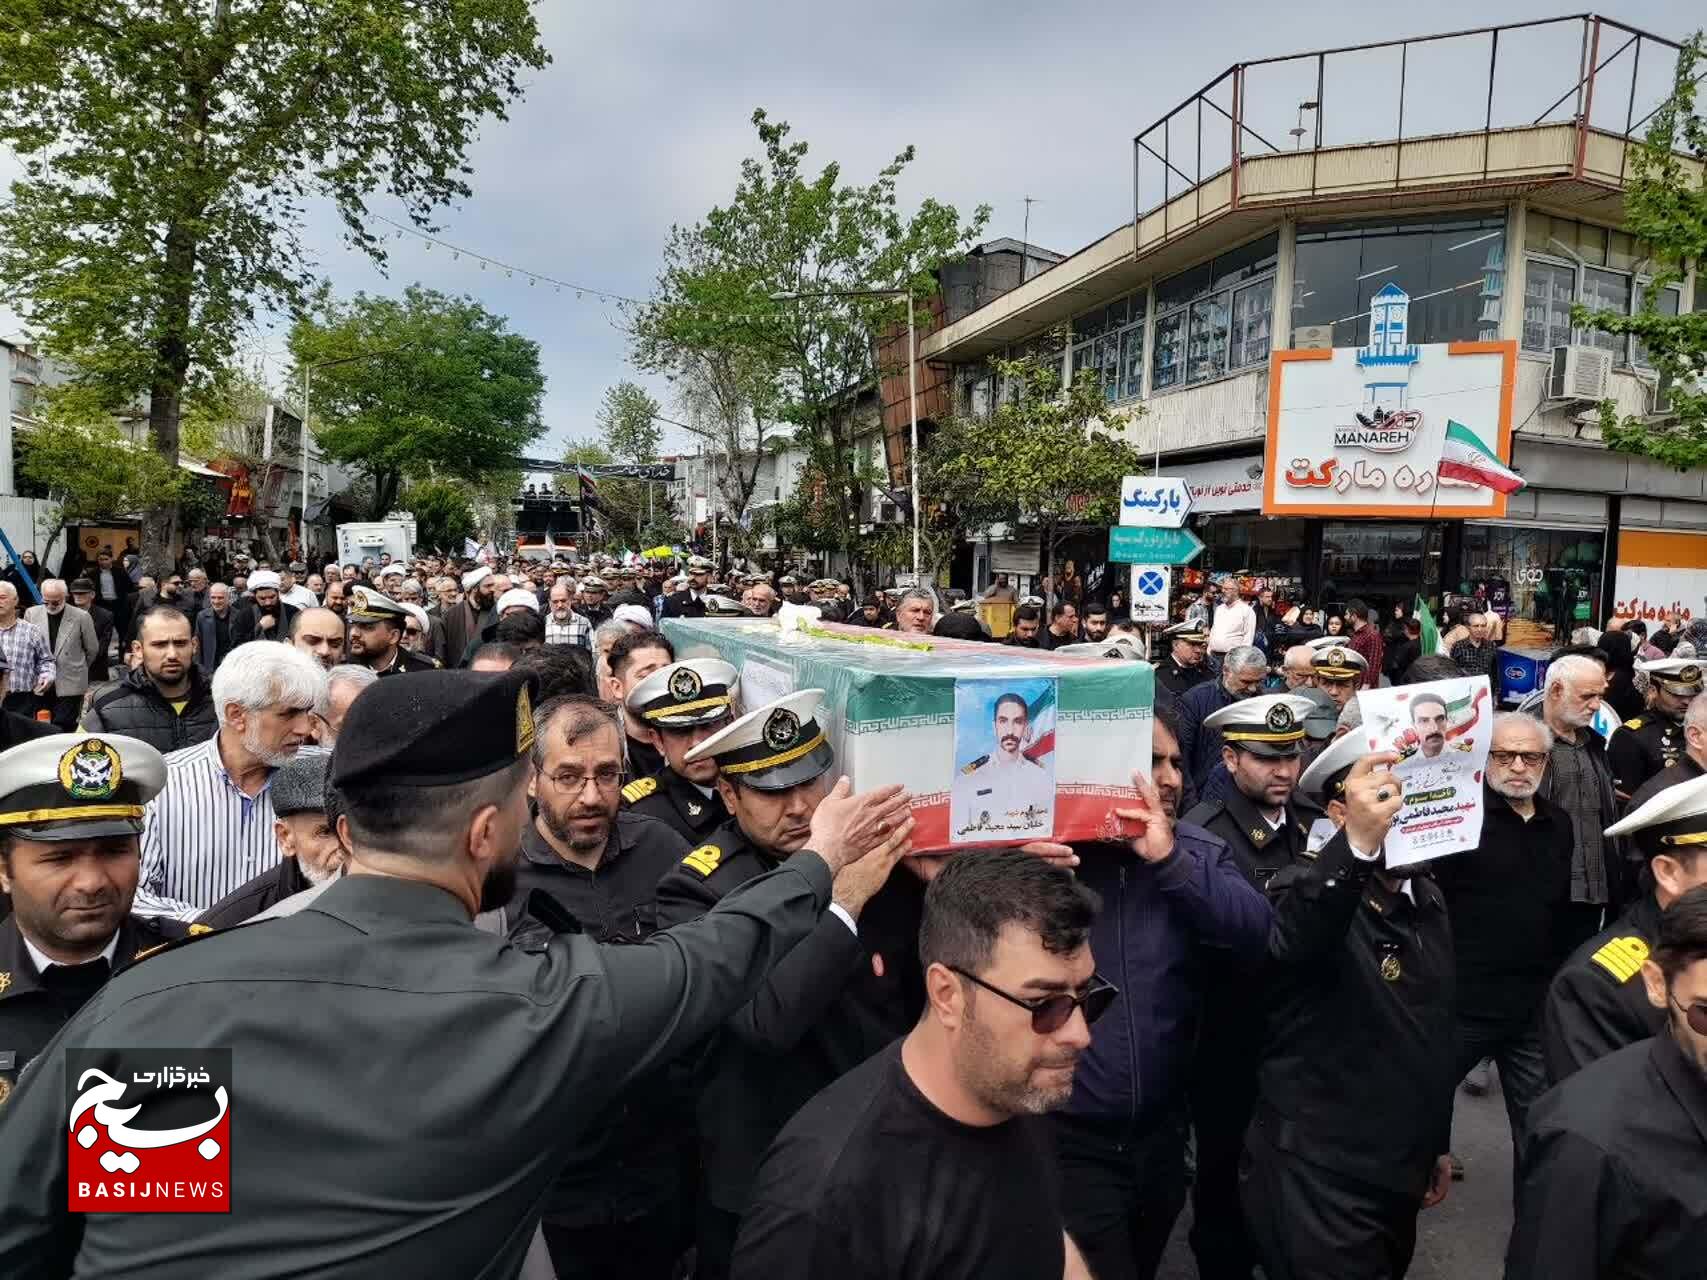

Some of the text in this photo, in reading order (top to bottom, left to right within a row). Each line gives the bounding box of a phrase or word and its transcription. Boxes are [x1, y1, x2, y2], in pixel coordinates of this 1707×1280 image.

[1334, 431, 1409, 444] MANAREH
[1285, 457, 1386, 495] مارکت
[1123, 487, 1181, 515] پارکینگ
[1613, 597, 1656, 620] مارکت
